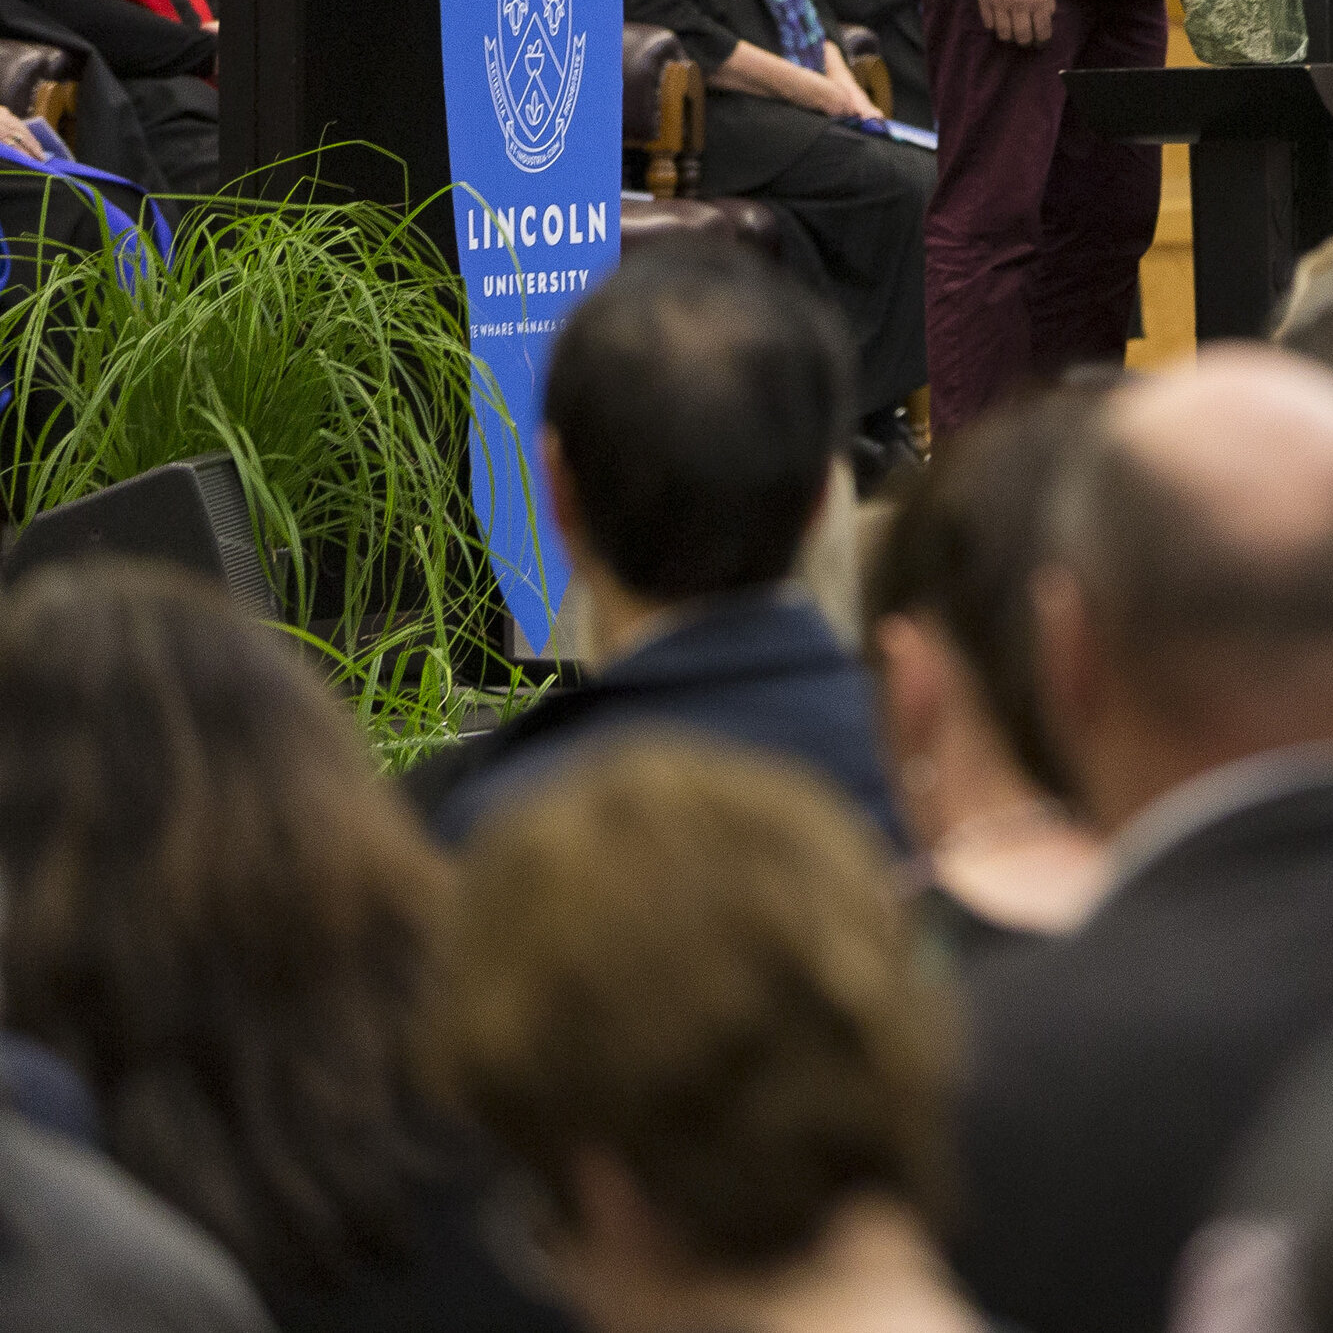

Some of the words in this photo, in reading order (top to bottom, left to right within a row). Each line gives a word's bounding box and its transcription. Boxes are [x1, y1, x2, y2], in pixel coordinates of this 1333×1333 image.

[468, 201, 607, 251] LINCOLN
[483, 269, 589, 298] UNIVERSITY
[480, 321, 514, 338] WHARE
